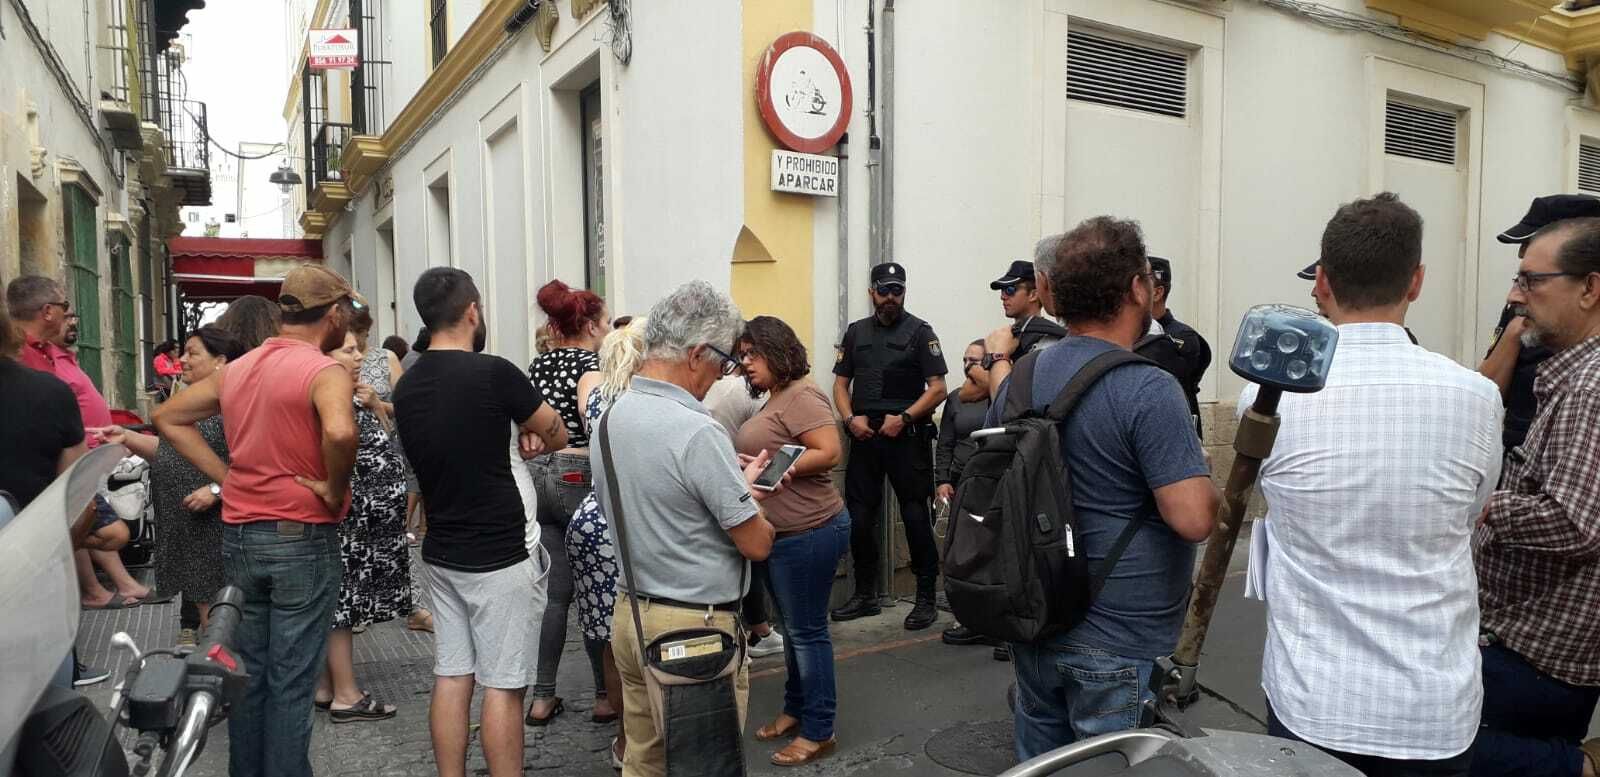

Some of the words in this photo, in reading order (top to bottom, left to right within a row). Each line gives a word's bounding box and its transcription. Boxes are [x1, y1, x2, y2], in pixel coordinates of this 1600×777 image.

[777, 154, 783, 169] Y
[786, 155, 837, 175] PROHIBIDO
[778, 172, 834, 192] APARCAR
